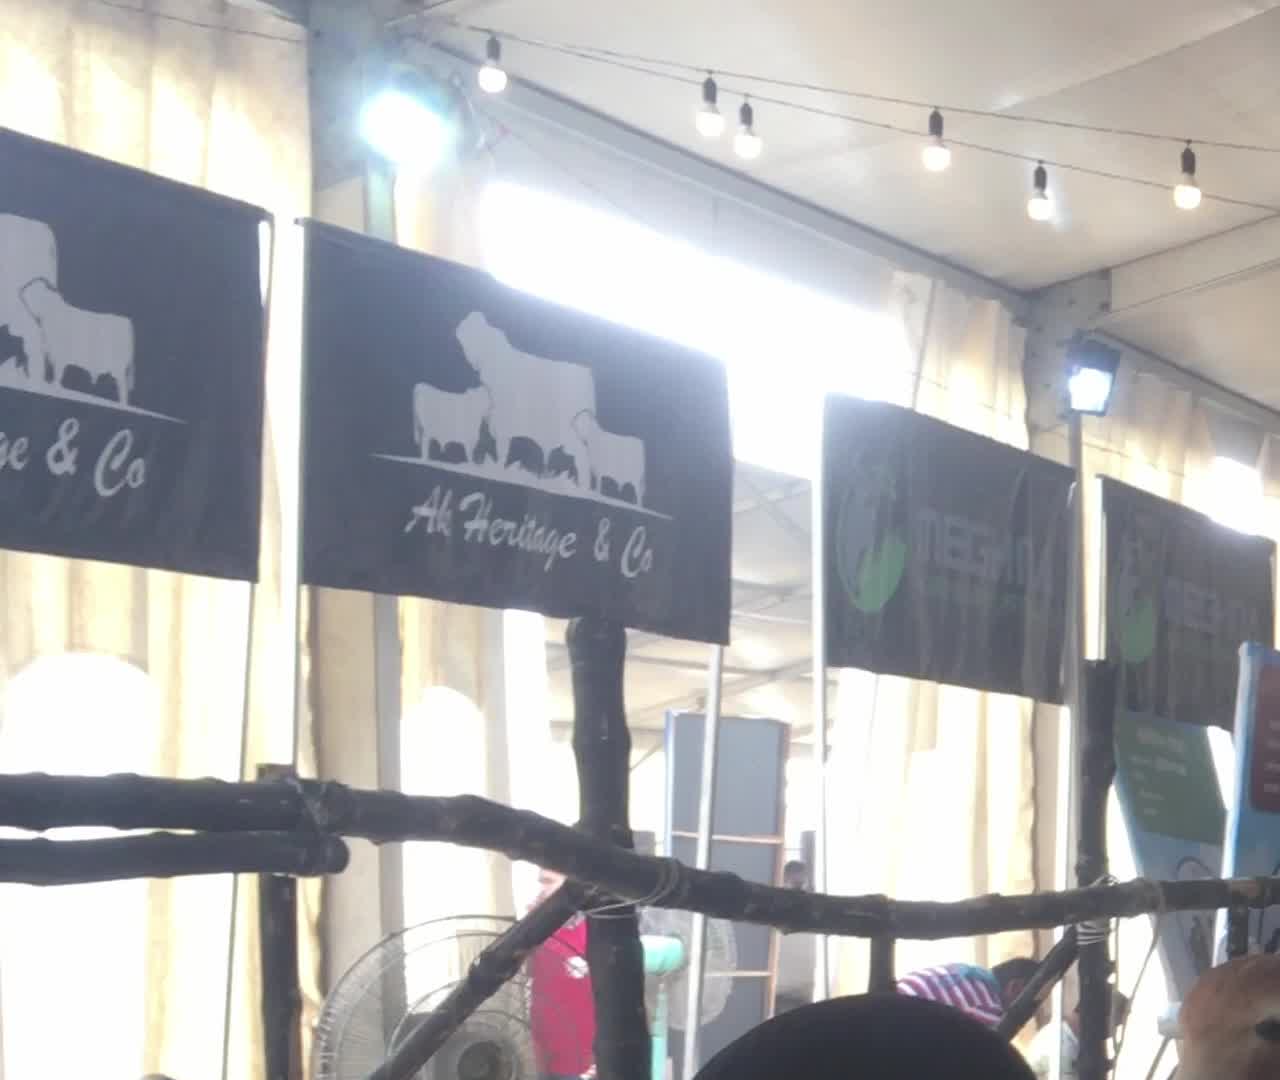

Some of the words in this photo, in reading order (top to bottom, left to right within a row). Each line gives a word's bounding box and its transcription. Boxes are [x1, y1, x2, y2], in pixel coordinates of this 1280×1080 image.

[46, 417, 80, 475] &
[94, 428, 146, 497] Co
[404, 485, 453, 537] Ak
[459, 492, 577, 573] Heritage
[594, 517, 612, 562] &
[620, 526, 654, 578] Co
